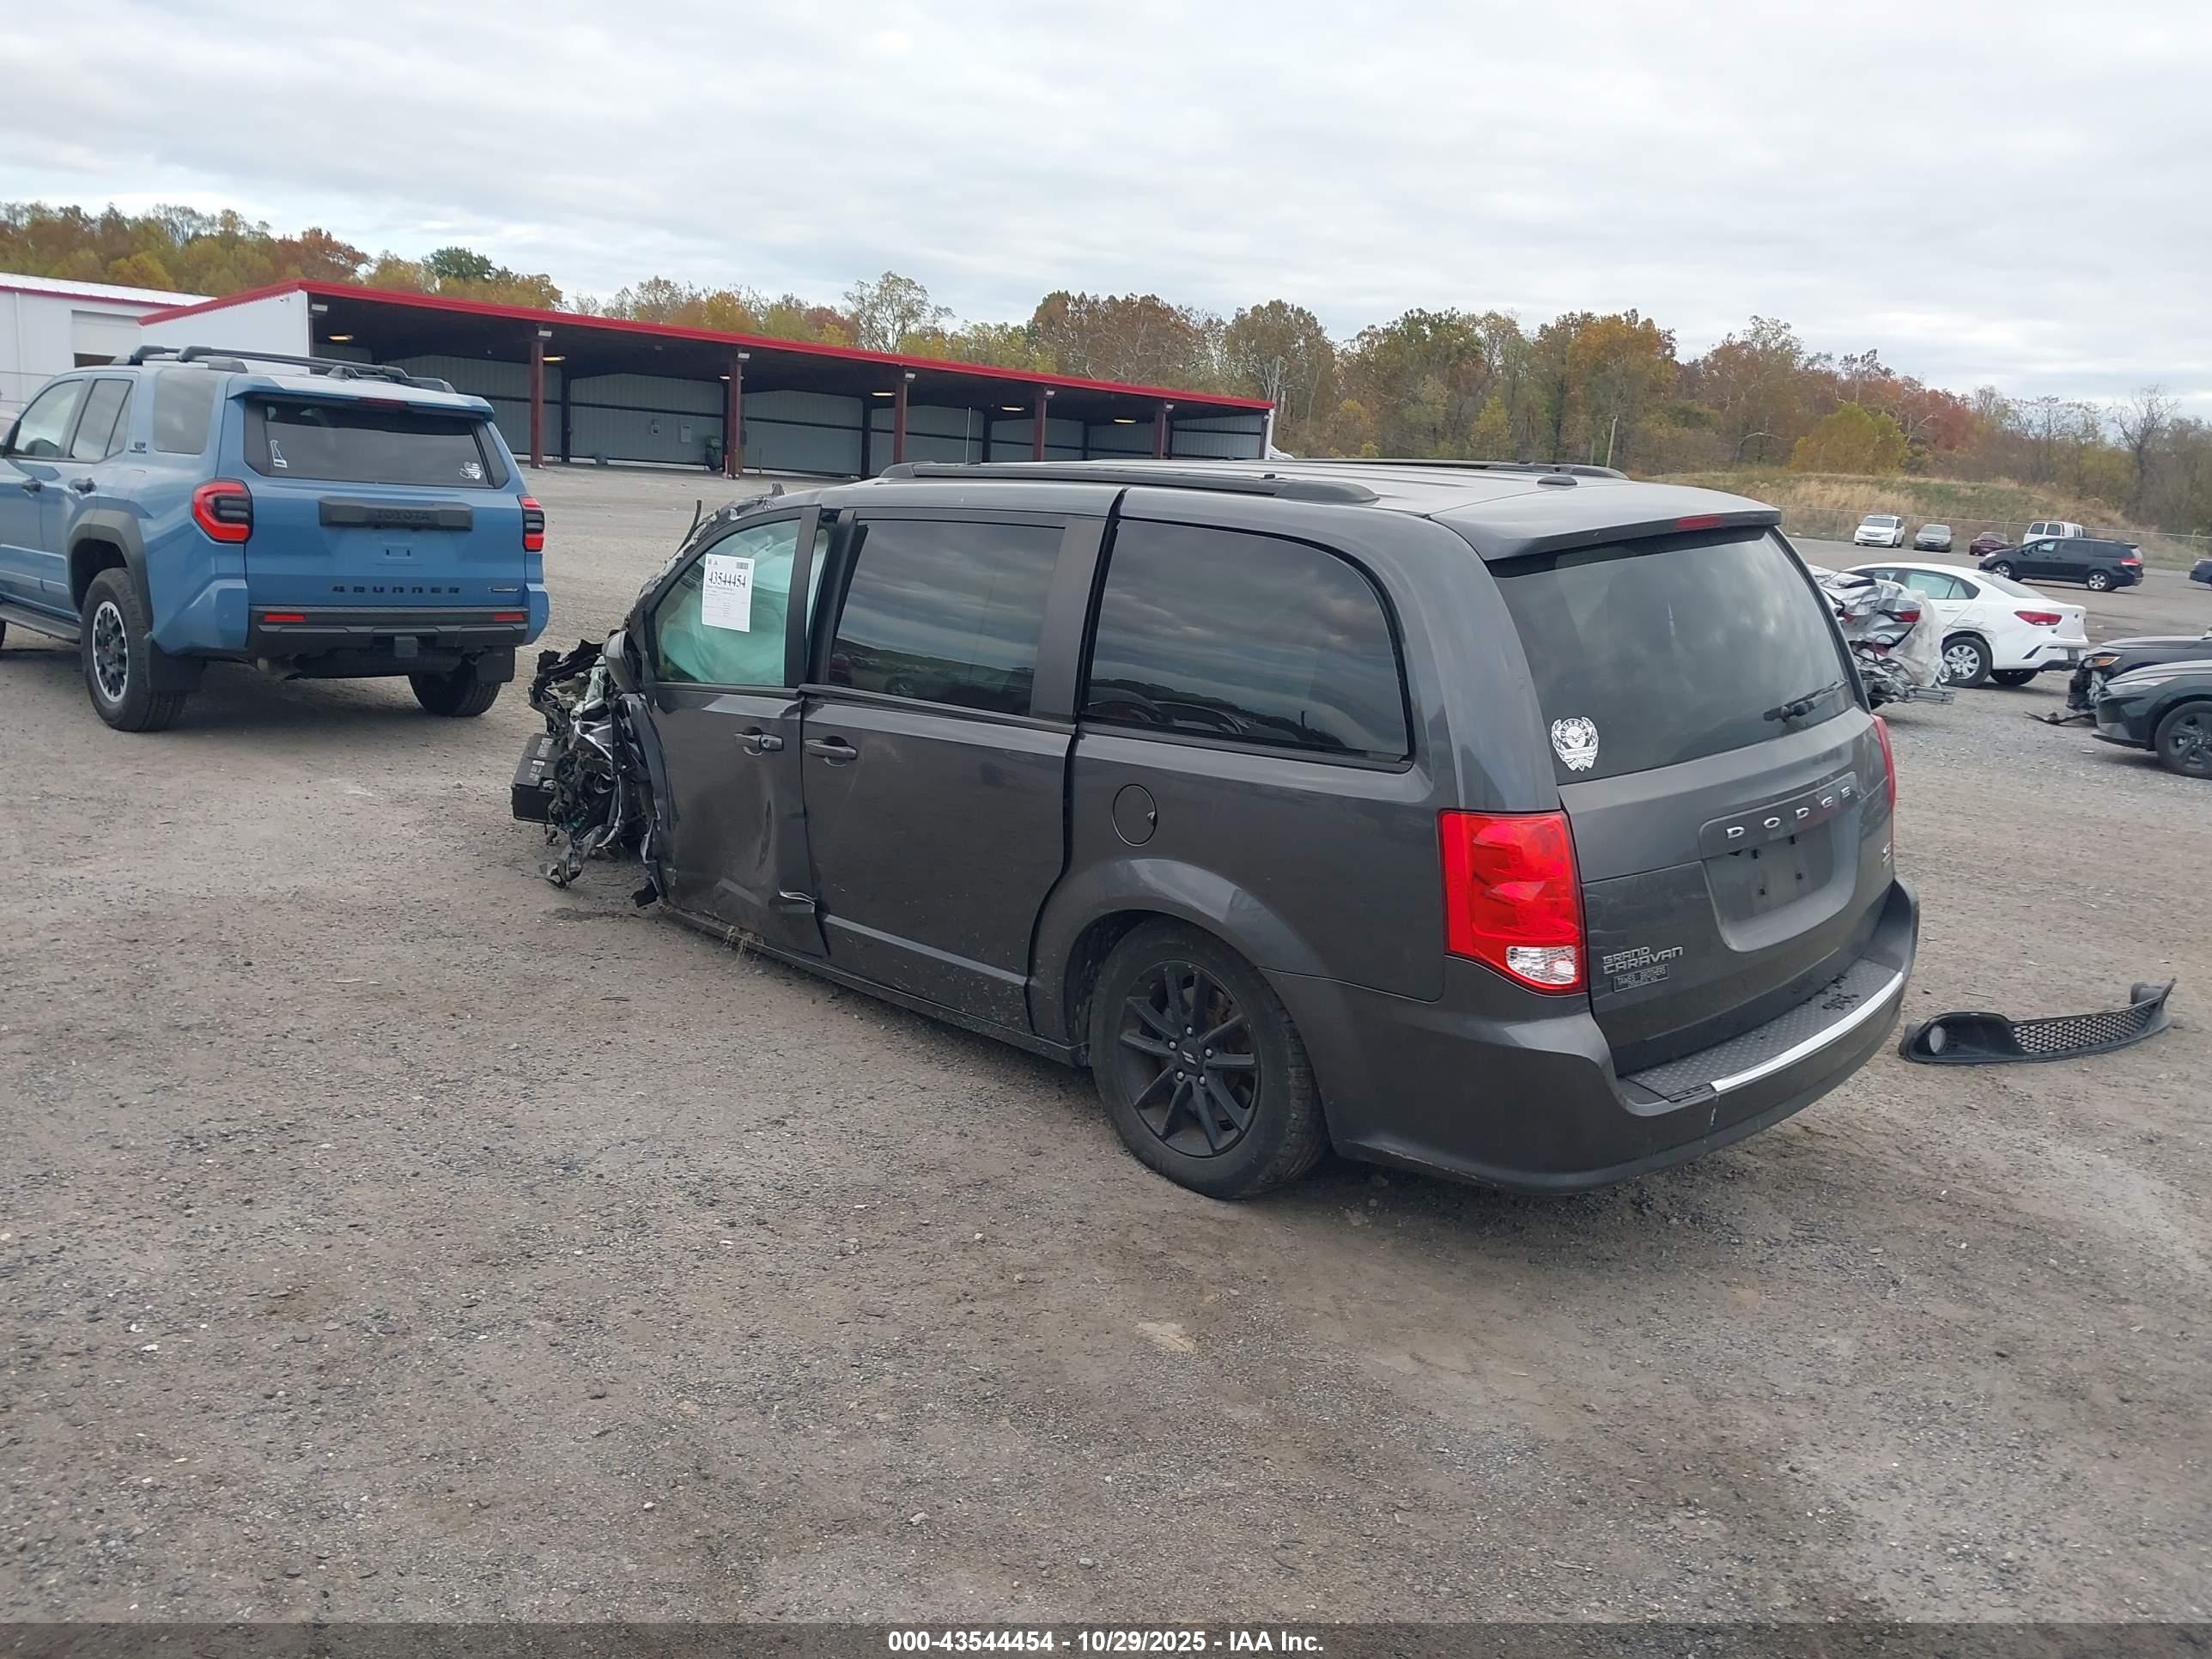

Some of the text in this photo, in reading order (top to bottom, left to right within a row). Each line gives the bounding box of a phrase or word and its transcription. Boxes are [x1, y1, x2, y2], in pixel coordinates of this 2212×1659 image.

[375, 509, 431, 521] TOYOTA
[708, 570, 747, 588] 43544454
[331, 585, 460, 594] 4RUNNER
[1726, 786, 1850, 839] DODGE
[1602, 946, 1650, 964] GRAND
[1603, 946, 1684, 975] CARAVAN
